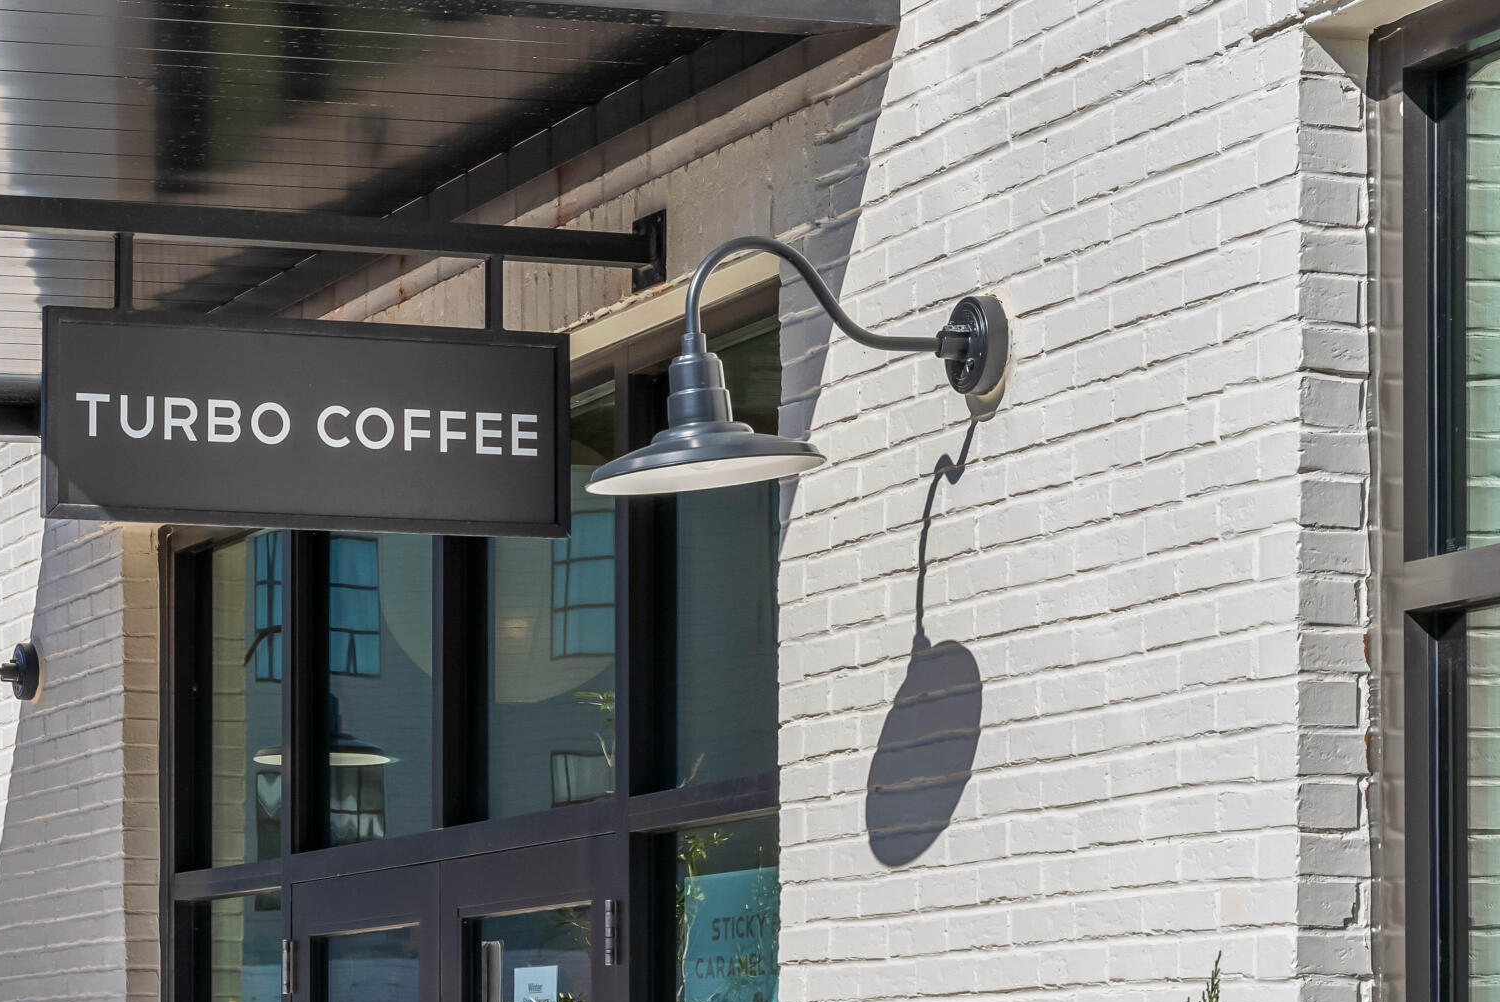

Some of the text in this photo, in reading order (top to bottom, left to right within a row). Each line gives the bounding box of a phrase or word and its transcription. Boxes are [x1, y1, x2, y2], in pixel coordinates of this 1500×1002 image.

[75, 392, 538, 457] TURBO COFFEE
[711, 913, 766, 942] STICKY
[695, 951, 766, 979] CARAMEL
